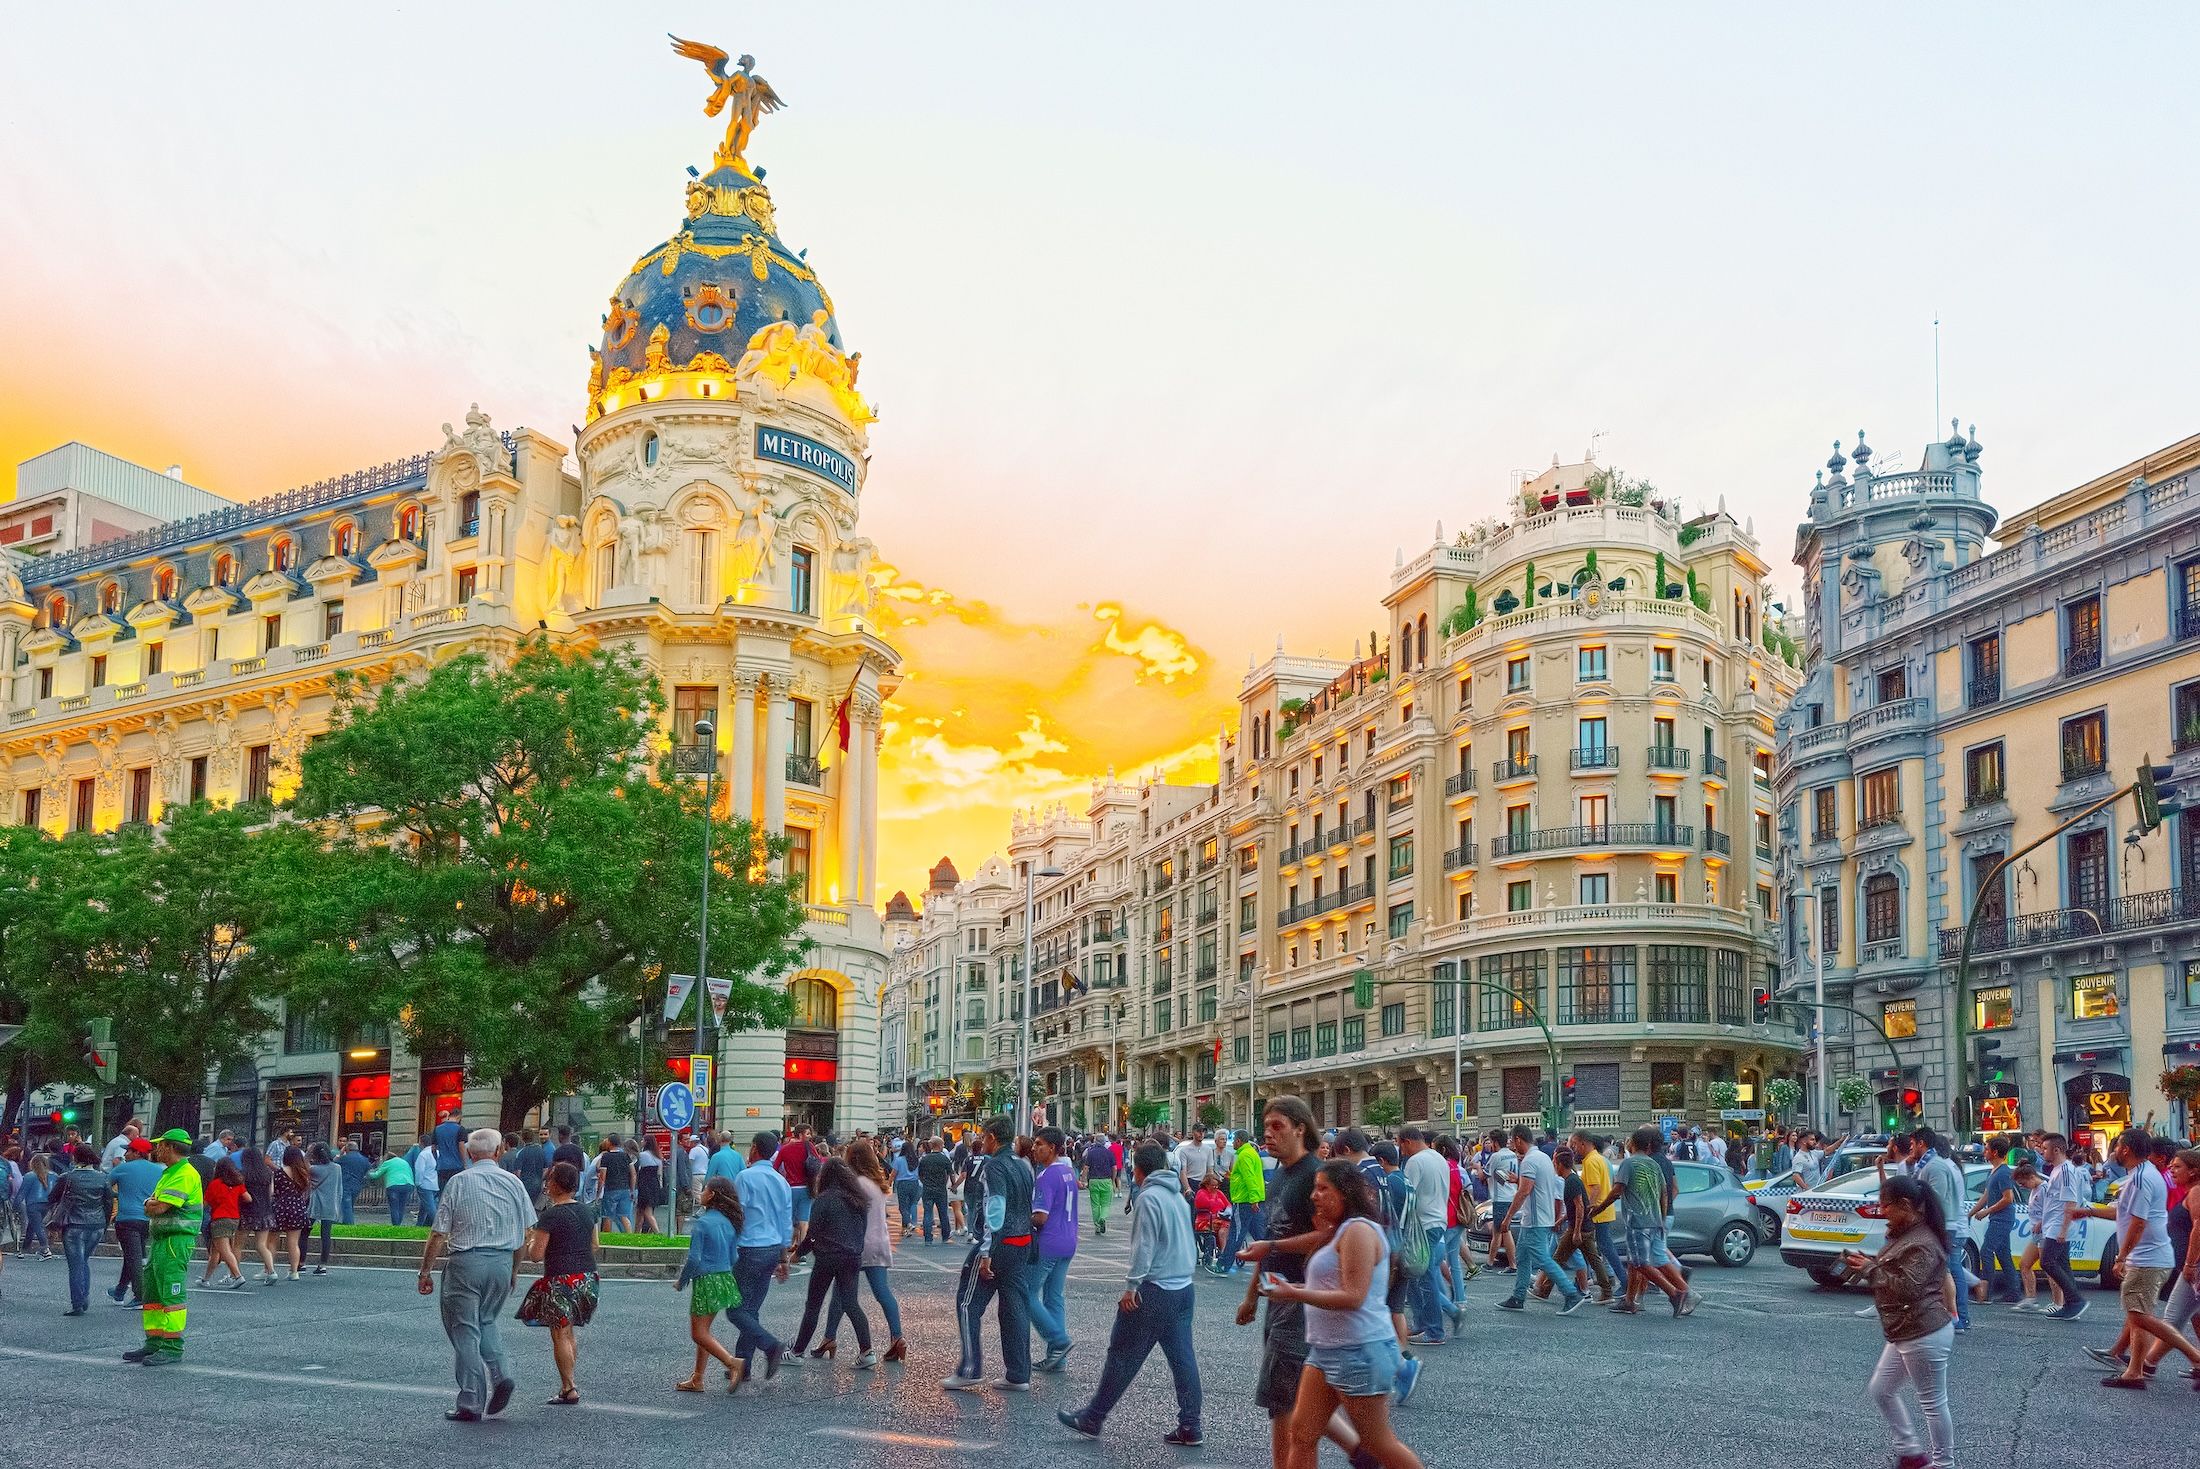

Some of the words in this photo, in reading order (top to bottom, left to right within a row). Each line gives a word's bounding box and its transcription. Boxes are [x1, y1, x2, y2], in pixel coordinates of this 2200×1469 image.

[763, 433, 854, 486] METROPOLIS
[2075, 975, 2115, 990] SOUVENIR
[1976, 989, 2012, 1003] SOUVENIR
[1885, 1000, 1916, 1014] SOUVENIR
[1663, 1121, 1672, 1131] P
[1687, 1145, 1694, 1160] 5
[971, 1160, 982, 1177] 7
